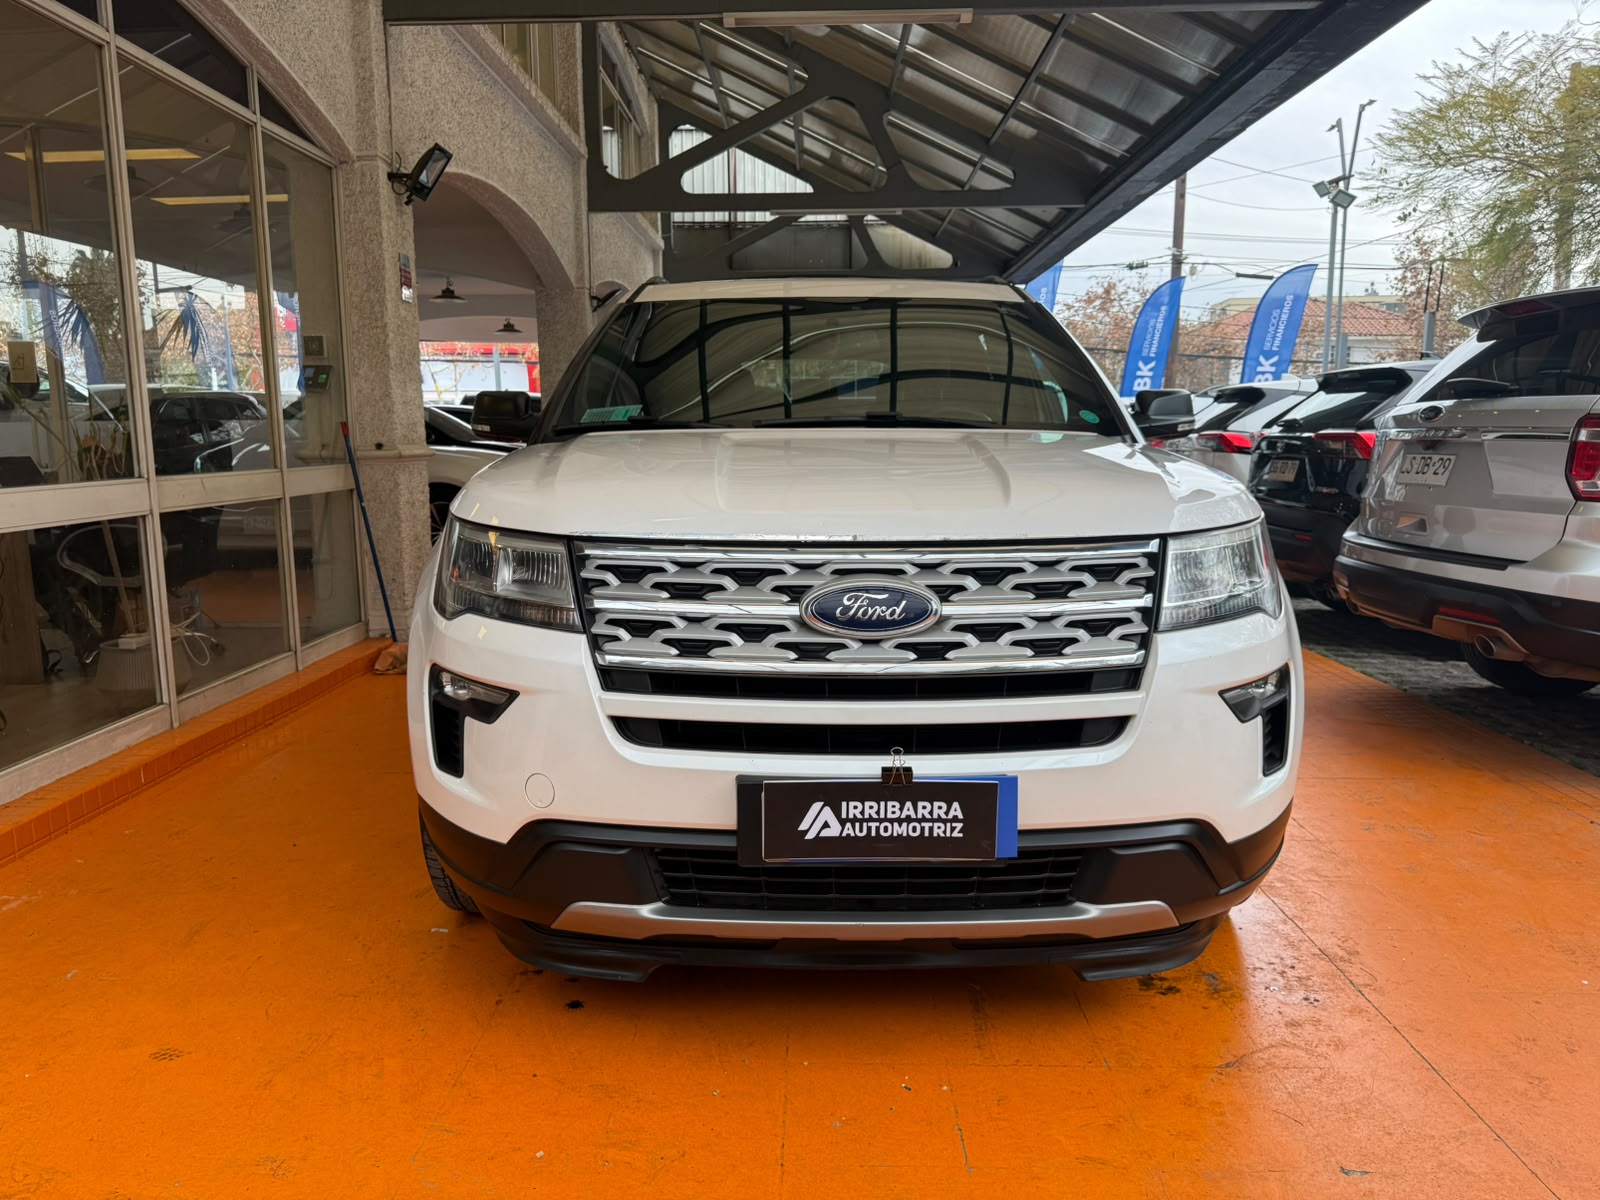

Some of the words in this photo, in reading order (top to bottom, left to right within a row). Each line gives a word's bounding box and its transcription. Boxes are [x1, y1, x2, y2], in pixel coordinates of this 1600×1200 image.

[1149, 305, 1168, 358] FINANCIEROS
[1263, 308, 1281, 351] SERVICIOS
[1271, 294, 1294, 352] FINANCIEROS
[1132, 360, 1156, 391] BK
[1254, 354, 1279, 383] BK
[835, 592, 907, 621] Ford
[841, 801, 964, 819] IRRIBARRA
[841, 822, 964, 837] AUTOMOTRIZ
